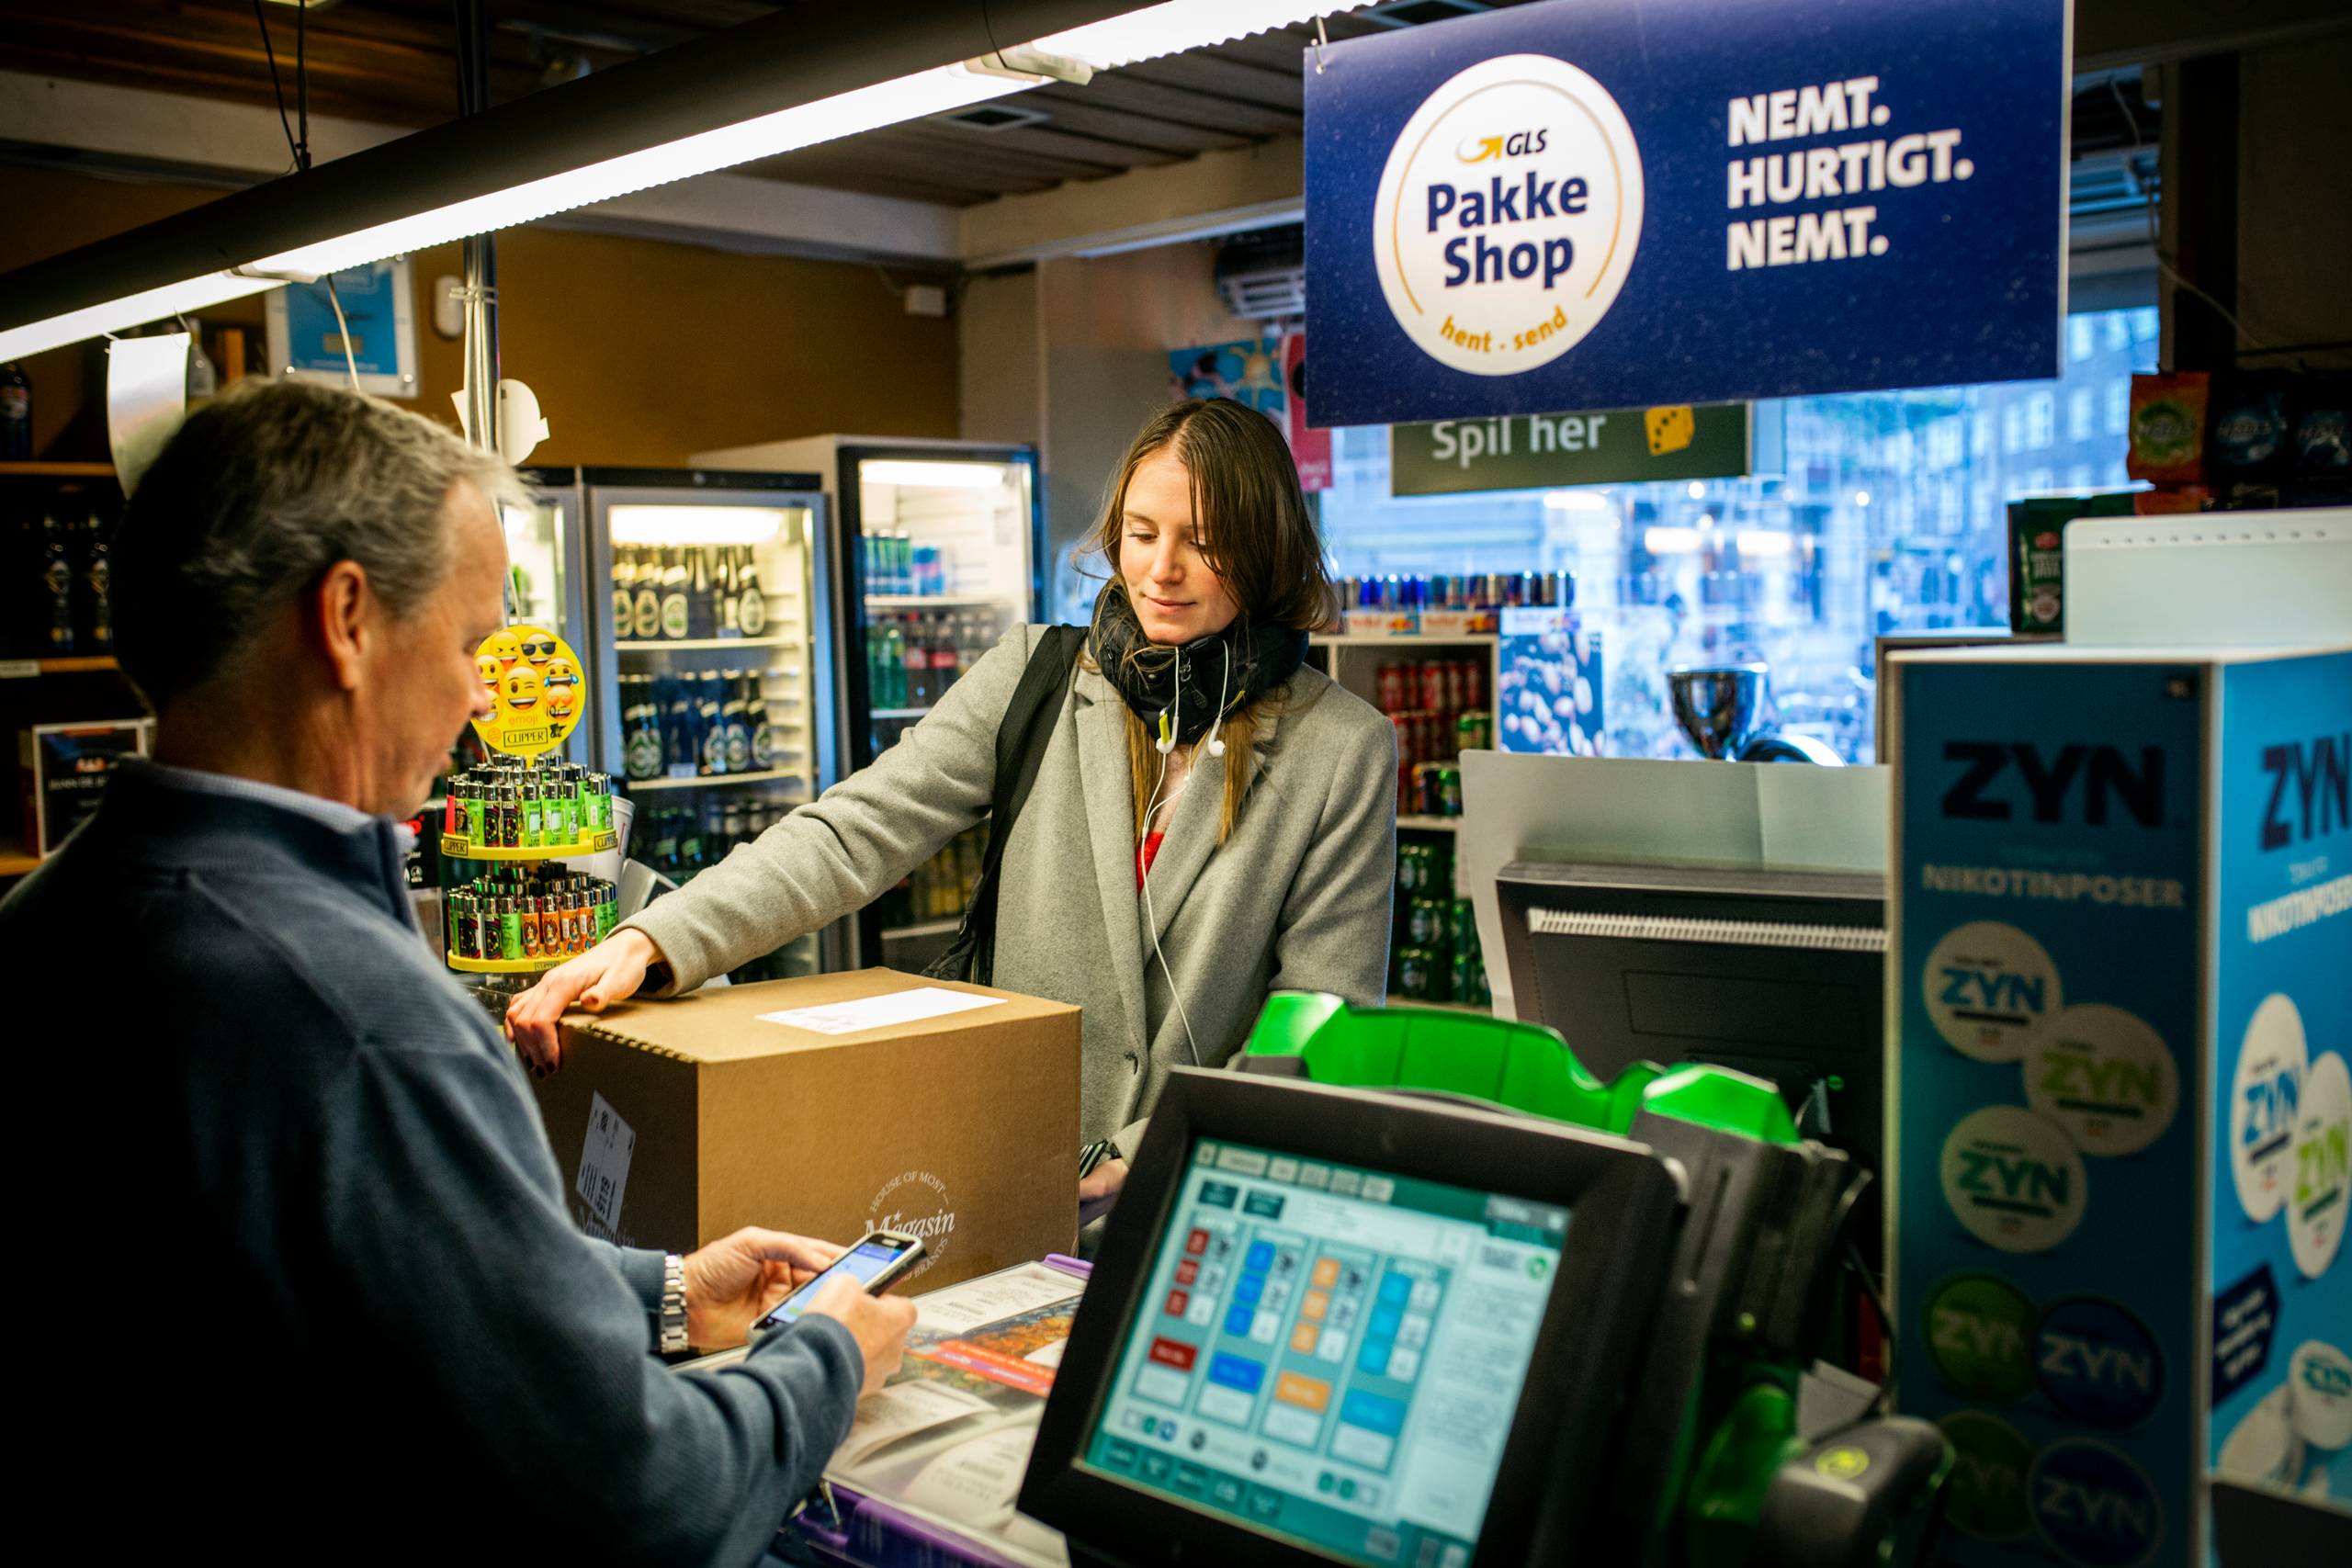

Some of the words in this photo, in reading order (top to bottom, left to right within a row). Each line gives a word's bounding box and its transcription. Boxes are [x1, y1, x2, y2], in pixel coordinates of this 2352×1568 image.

[1727, 75, 1891, 147] NEMT.
[1506, 128, 1548, 156] GLS
[1727, 128, 1974, 209] HURTIGT.
[1427, 171, 1589, 232] Pakke
[1444, 234, 1574, 290] Shop
[1726, 205, 1890, 271] NEMT.
[1440, 314, 1492, 354] hent
[1513, 305, 1569, 352] send
[1431, 416, 1512, 469] Spil
[1529, 414, 1607, 453] her
[507, 731, 545, 744] CLIPPER
[1941, 739, 2165, 829] ZYN
[2260, 731, 2352, 852] ZYN
[1921, 863, 2187, 908] NIKOTINPOSER
[2247, 874, 2352, 942] NIKOTINPOSE
[1940, 967, 2043, 1013] ZYN
[2041, 1050, 2158, 1106] ZYN
[869, 1176, 903, 1213] HOUSE
[903, 1171, 918, 1183] OF
[919, 1171, 946, 1194] MOST
[1958, 1149, 2069, 1206] ZYN
[2040, 1331, 2155, 1393] ZYN
[2040, 1472, 2149, 1539] ZYN
